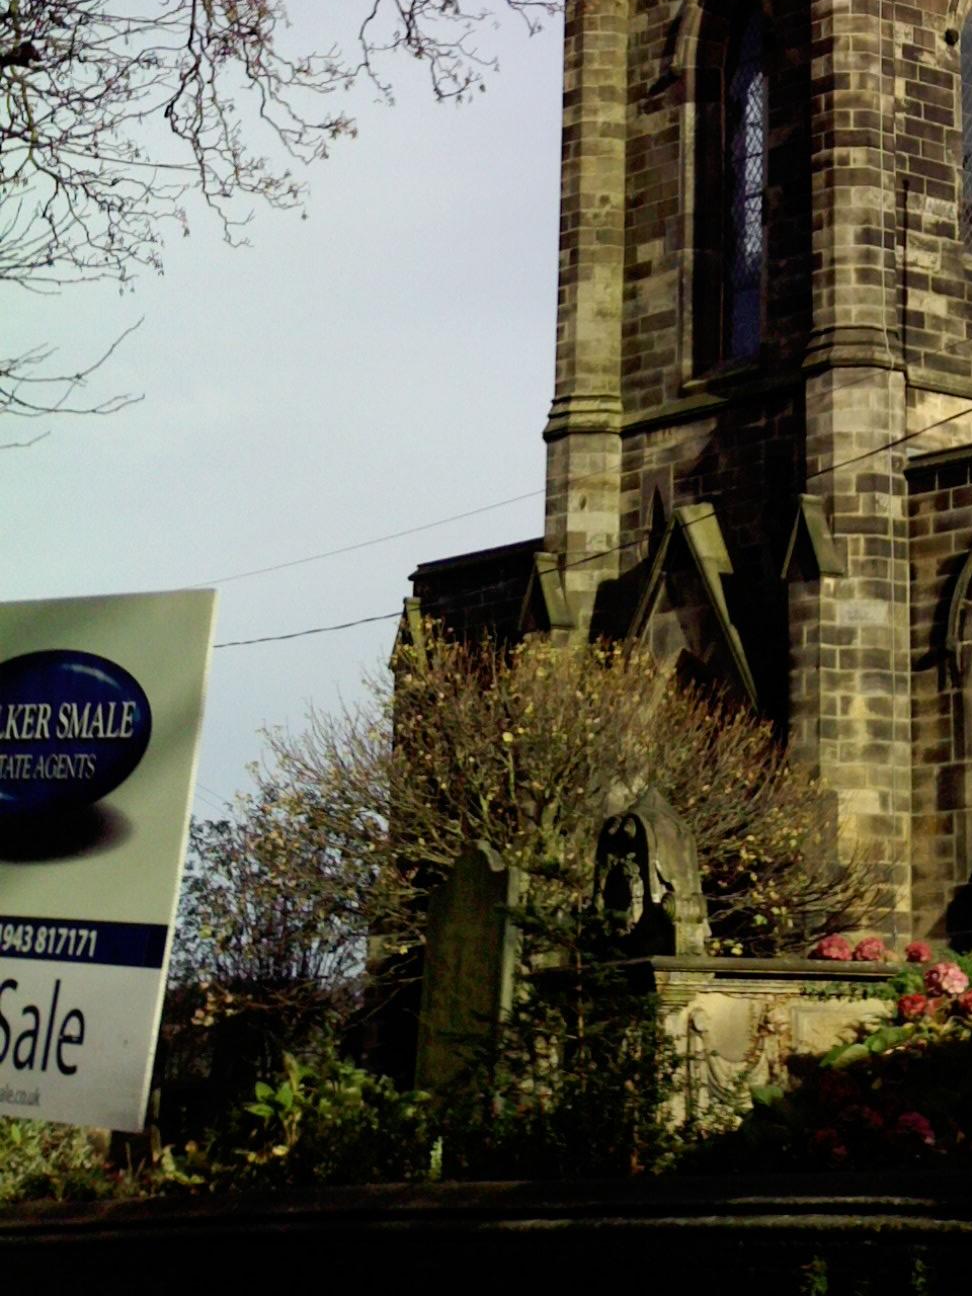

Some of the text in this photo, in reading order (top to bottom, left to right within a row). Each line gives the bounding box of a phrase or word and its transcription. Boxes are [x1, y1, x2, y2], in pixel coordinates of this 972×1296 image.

[56, 701, 137, 739] SMALE
[33, 753, 97, 780] AGENTS
[34, 925, 98, 958] 817171
